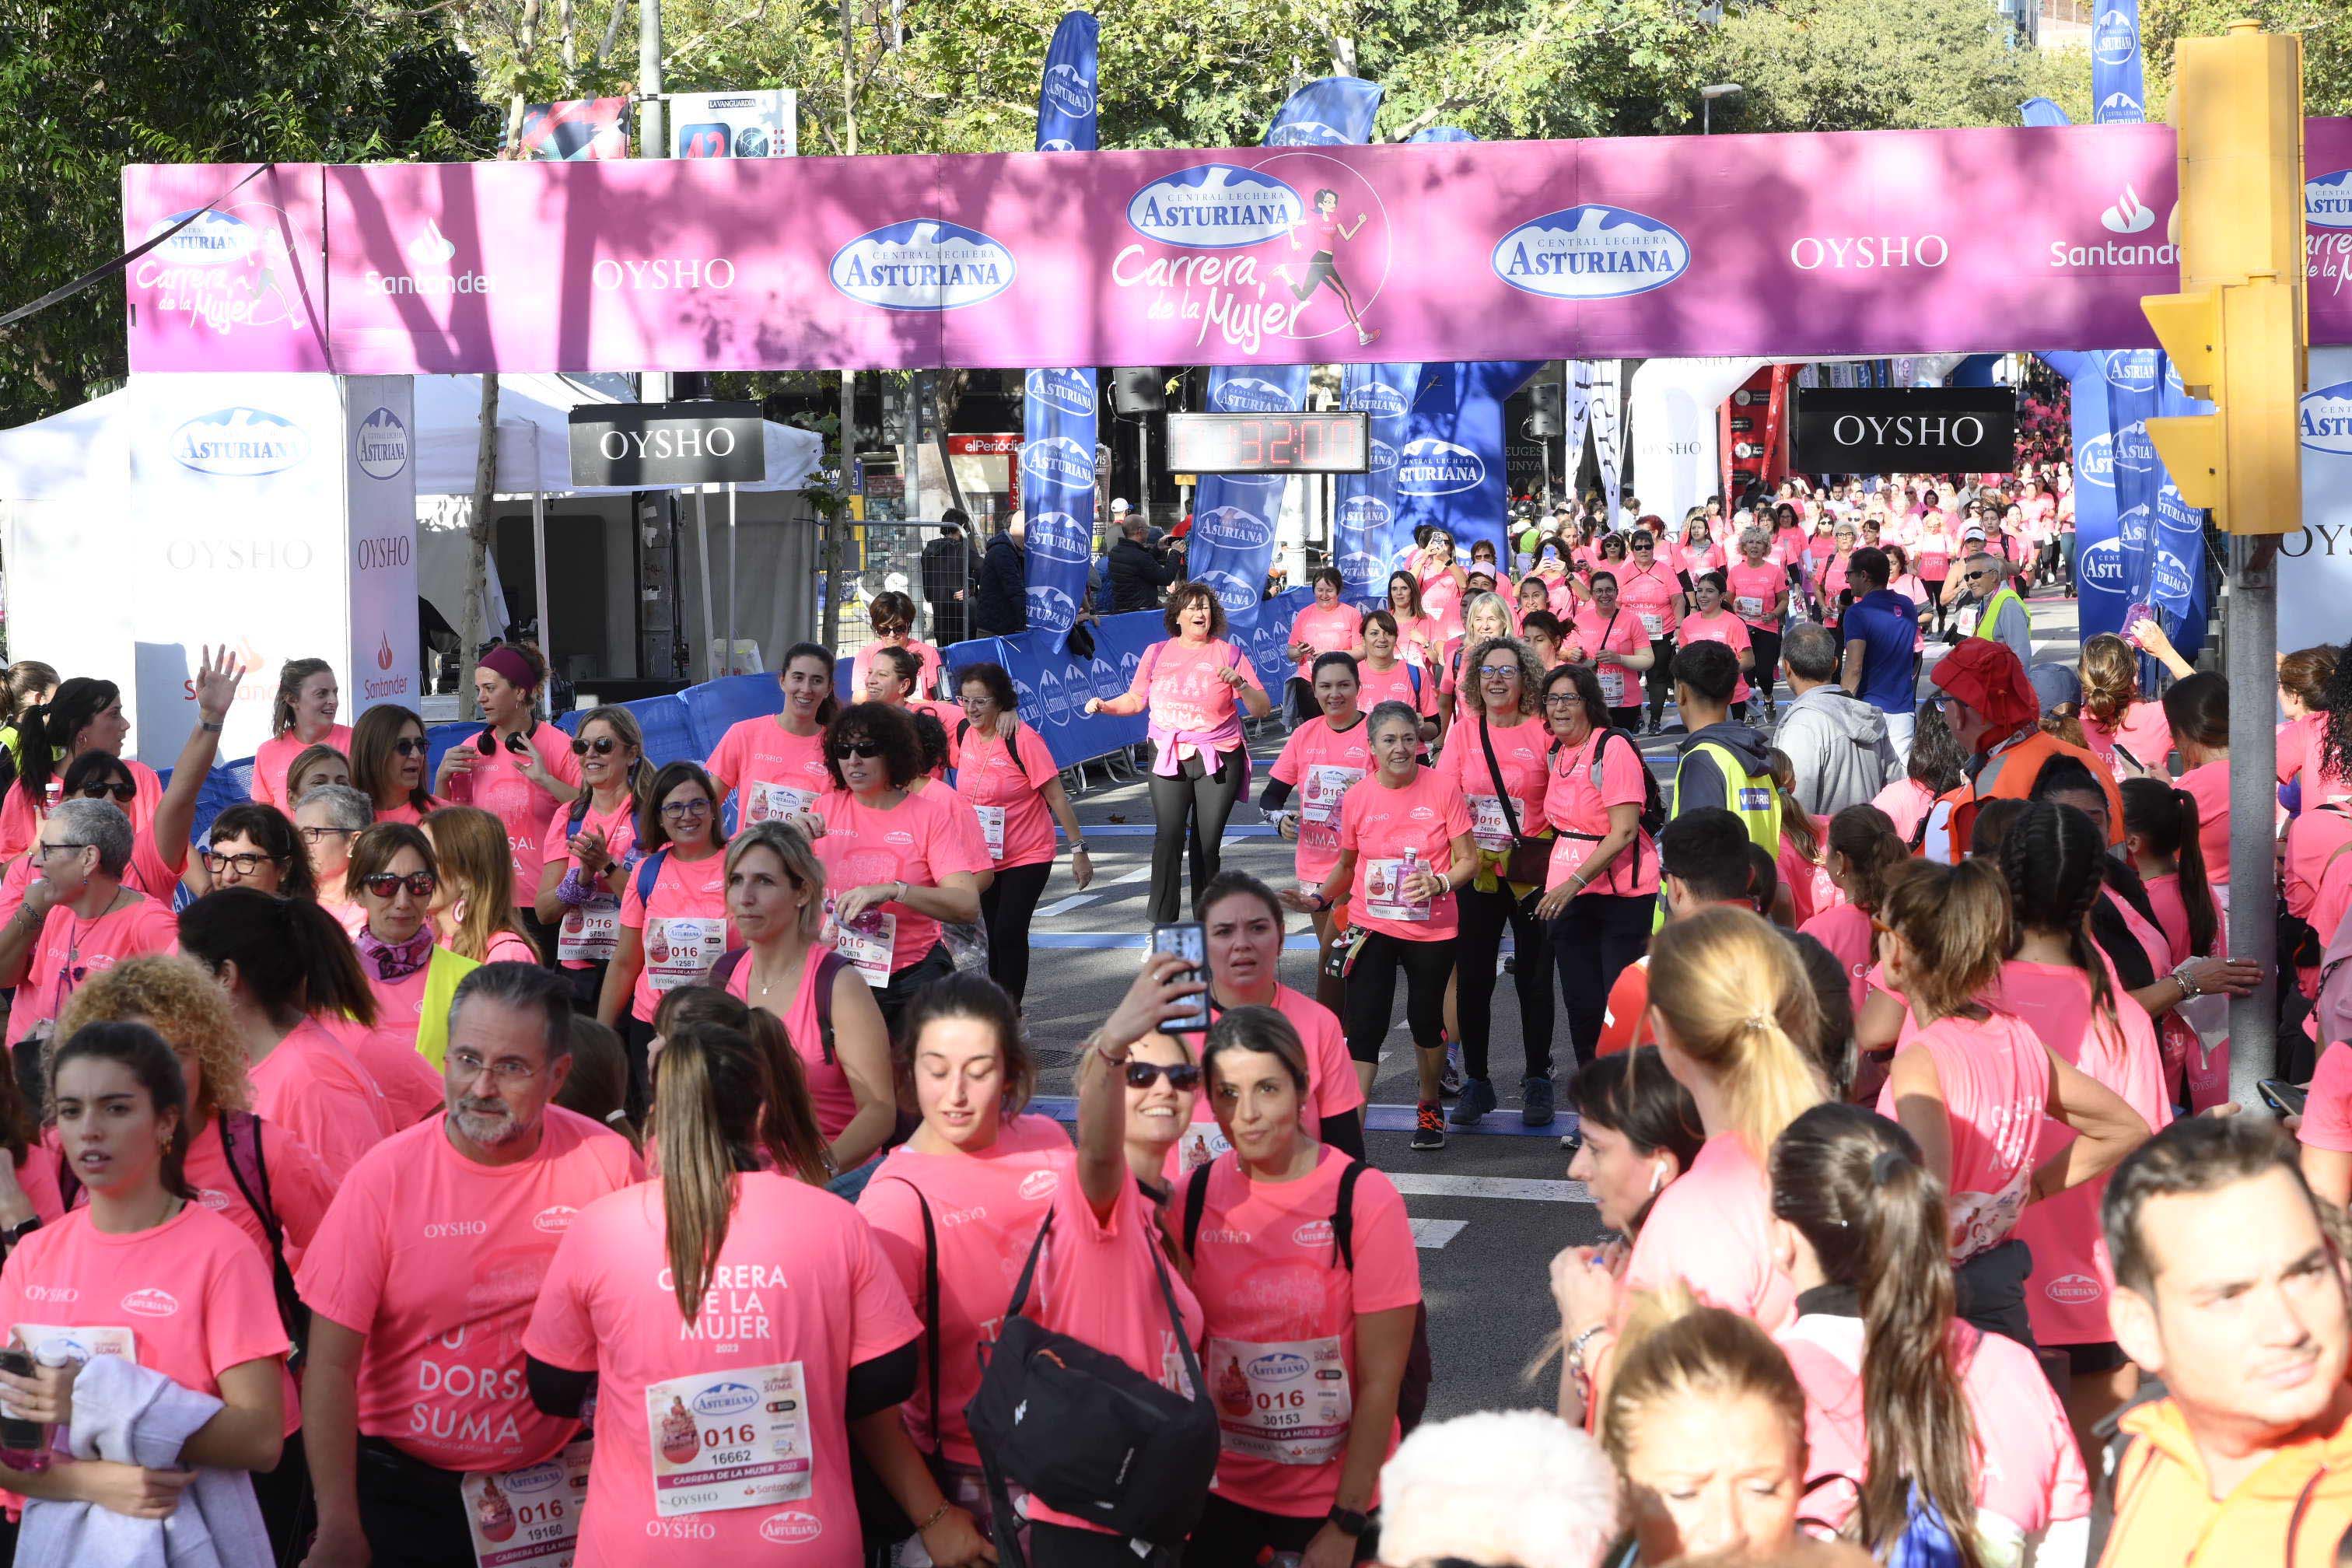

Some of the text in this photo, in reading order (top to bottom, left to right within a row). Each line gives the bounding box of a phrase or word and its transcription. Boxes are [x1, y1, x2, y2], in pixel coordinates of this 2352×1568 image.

[1167, 191, 1285, 201] CENTRAL LECHERA
[1141, 196, 1290, 227] ASTURIANA
[1538, 236, 1668, 247] CENTRAL LECHERA
[873, 249, 995, 259] CENTRAL LECHERA
[1507, 241, 1675, 275] ASTURIANA
[1790, 235, 1948, 269] OYSHO
[843, 255, 1002, 288] ASTURIANA
[1113, 243, 1255, 287] Carrera
[136, 260, 229, 289] Carrera
[365, 270, 498, 295] Santander
[592, 258, 735, 291] OYSHO
[159, 288, 261, 335] de la Mujer
[1147, 285, 1311, 355] de la Mujer
[1032, 375, 1092, 411] ASTURIANA
[1833, 415, 1984, 447] OYSHO
[360, 438, 404, 463] ASTURIANA
[599, 427, 735, 460] OYSHO
[965, 439, 1018, 453] elPeriódi
[1028, 450, 1092, 483] ASTURIANA
[1399, 467, 1478, 482] STURIANA
[1027, 525, 1087, 558] ASTURIANA
[166, 539, 313, 571] OYSHO
[358, 535, 409, 570] OYSHO
[365, 674, 408, 700] Santander
[1156, 709, 1204, 724] SUMA
[754, 752, 782, 765] OYSHO
[770, 809, 793, 821] 016
[1365, 813, 1389, 823] OYSHO
[1479, 816, 1501, 825] 016
[827, 828, 859, 838] OYSHO
[586, 919, 612, 929] 016
[839, 936, 865, 948] 016
[671, 946, 698, 957] 016
[424, 1220, 486, 1238] OYSHO
[1201, 1230, 1251, 1244] OYSHO
[25, 1283, 78, 1302] OYSHO
[2050, 1285, 2100, 1297] ASTURIANA
[126, 1295, 173, 1313] ASTURIANA
[730, 1290, 764, 1314] LA
[680, 1316, 771, 1342] MUJER
[1252, 1365, 1304, 1376] ASTURIANA
[763, 1380, 793, 1393] SUMA
[698, 1395, 754, 1411] ASTURIANA
[1256, 1389, 1304, 1409] 016
[409, 1401, 521, 1444] SUMA
[1262, 1413, 1300, 1426] 30153
[703, 1423, 755, 1448] 016
[1280, 1429, 1291, 1437] LA
[1293, 1429, 1319, 1437] MUJER
[711, 1449, 751, 1466] 16662
[673, 1461, 798, 1486] CARRERA DE LA MUJER 2023
[757, 1479, 805, 1494] Santander
[671, 1491, 719, 1507] OYSHO
[519, 1499, 564, 1524] 016
[527, 1524, 563, 1542] 19160
[646, 1520, 716, 1541] OYSHO
[763, 1520, 817, 1538] ASTURIANA
[496, 1550, 533, 1562] CARRERA
